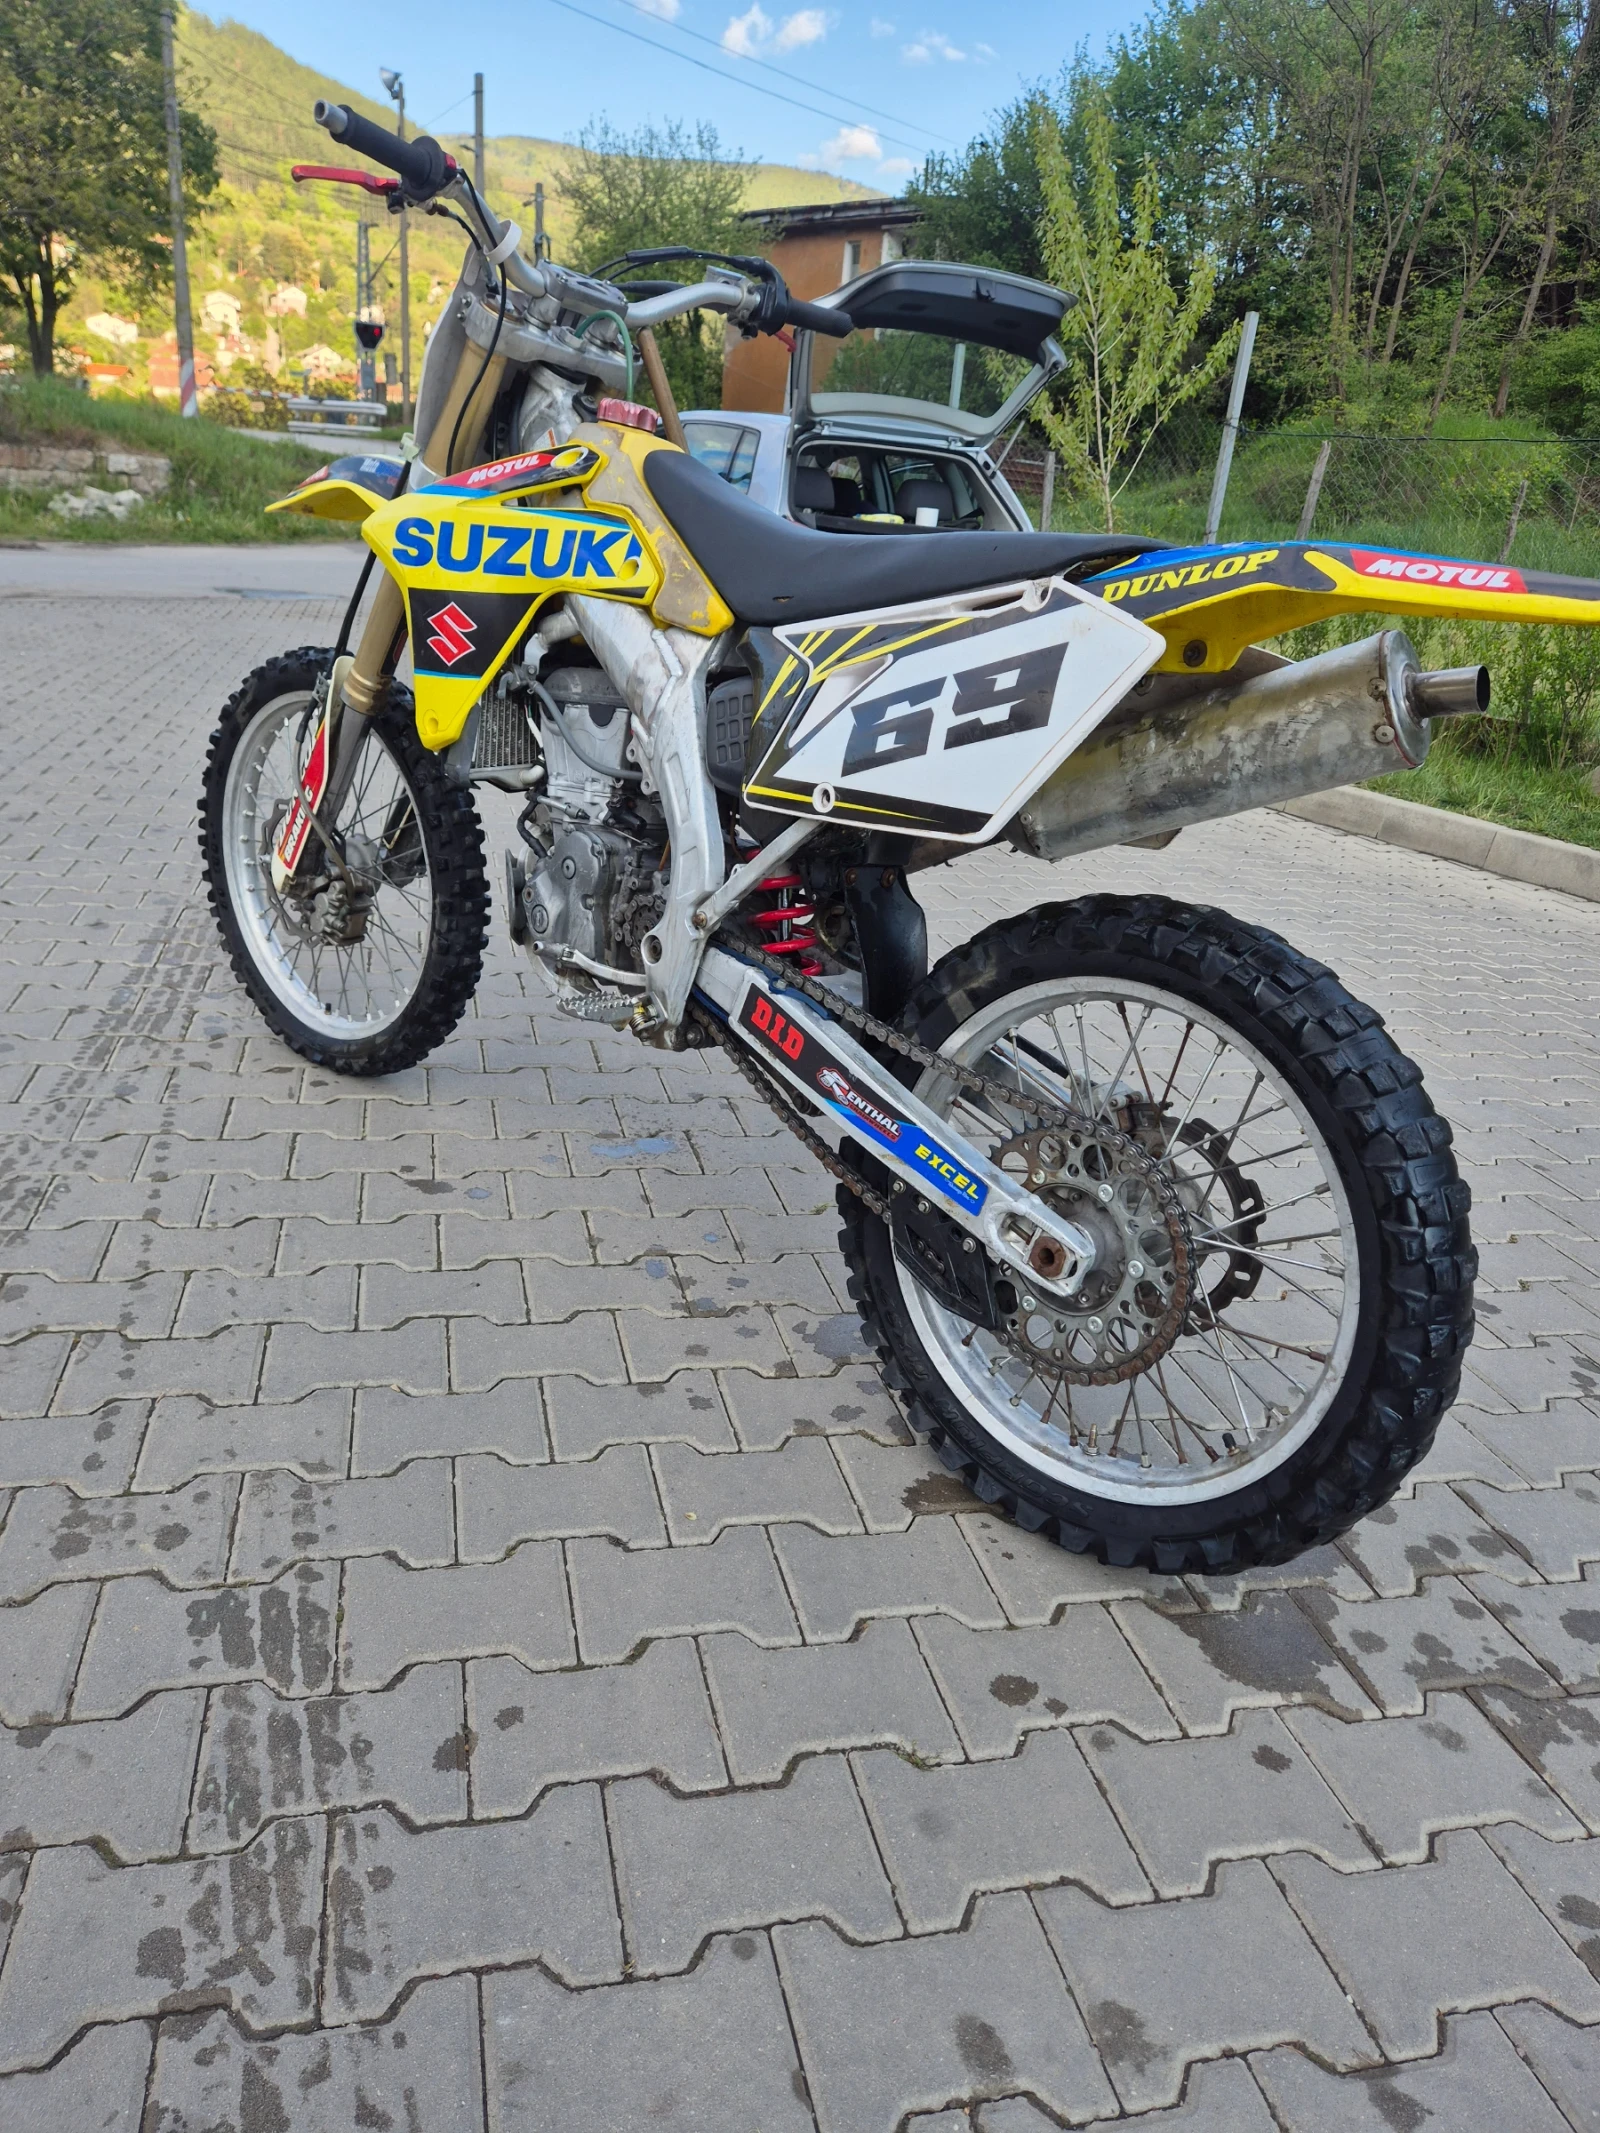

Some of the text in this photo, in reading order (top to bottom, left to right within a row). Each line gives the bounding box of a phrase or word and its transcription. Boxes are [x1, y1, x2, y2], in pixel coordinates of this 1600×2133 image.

[466, 454, 541, 485] MOTUL
[1102, 549, 1279, 602] DUNLOP
[1366, 558, 1511, 588] MOTUL
[841, 641, 1069, 777] 69
[284, 784, 313, 862] BRAKIG
[751, 996, 804, 1060] D.I.D
[915, 1144, 979, 1199] EXCEL
